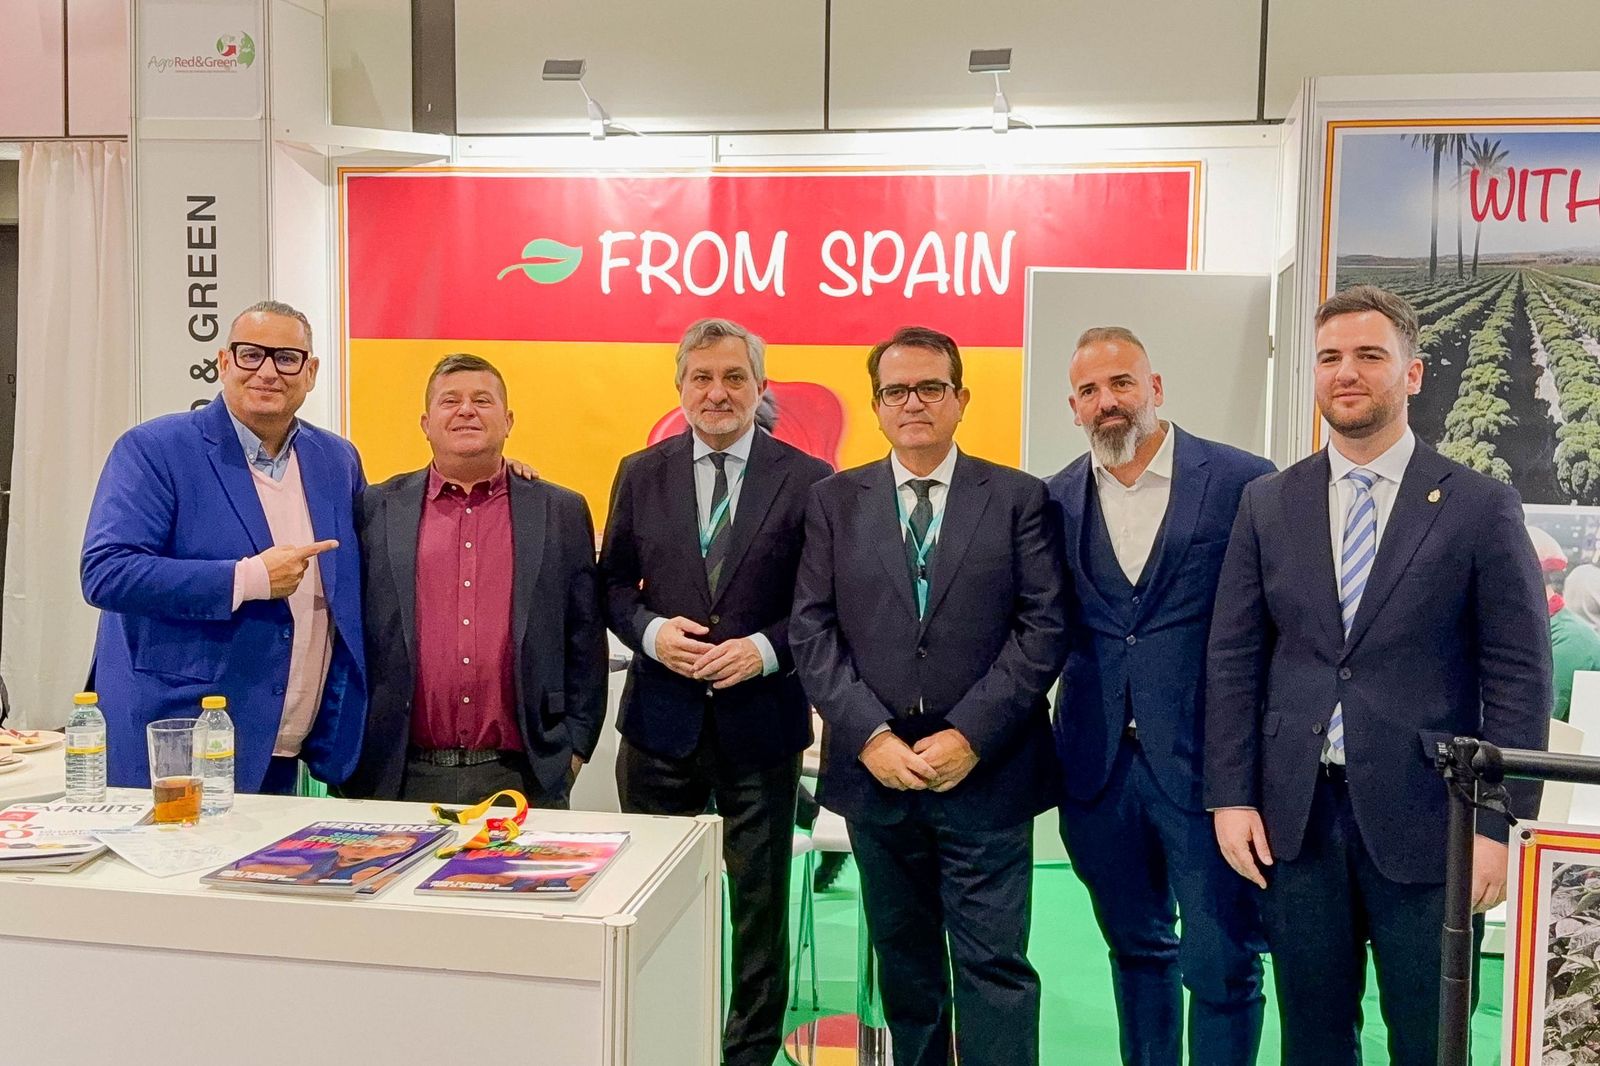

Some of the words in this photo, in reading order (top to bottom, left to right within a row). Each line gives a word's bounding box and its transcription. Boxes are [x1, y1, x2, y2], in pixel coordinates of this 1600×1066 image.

[1469, 166, 1600, 223] WITH
[186, 195, 219, 342] GREEN
[598, 230, 788, 298] FROM
[818, 230, 1017, 299] SPAIN
[189, 358, 219, 384] &
